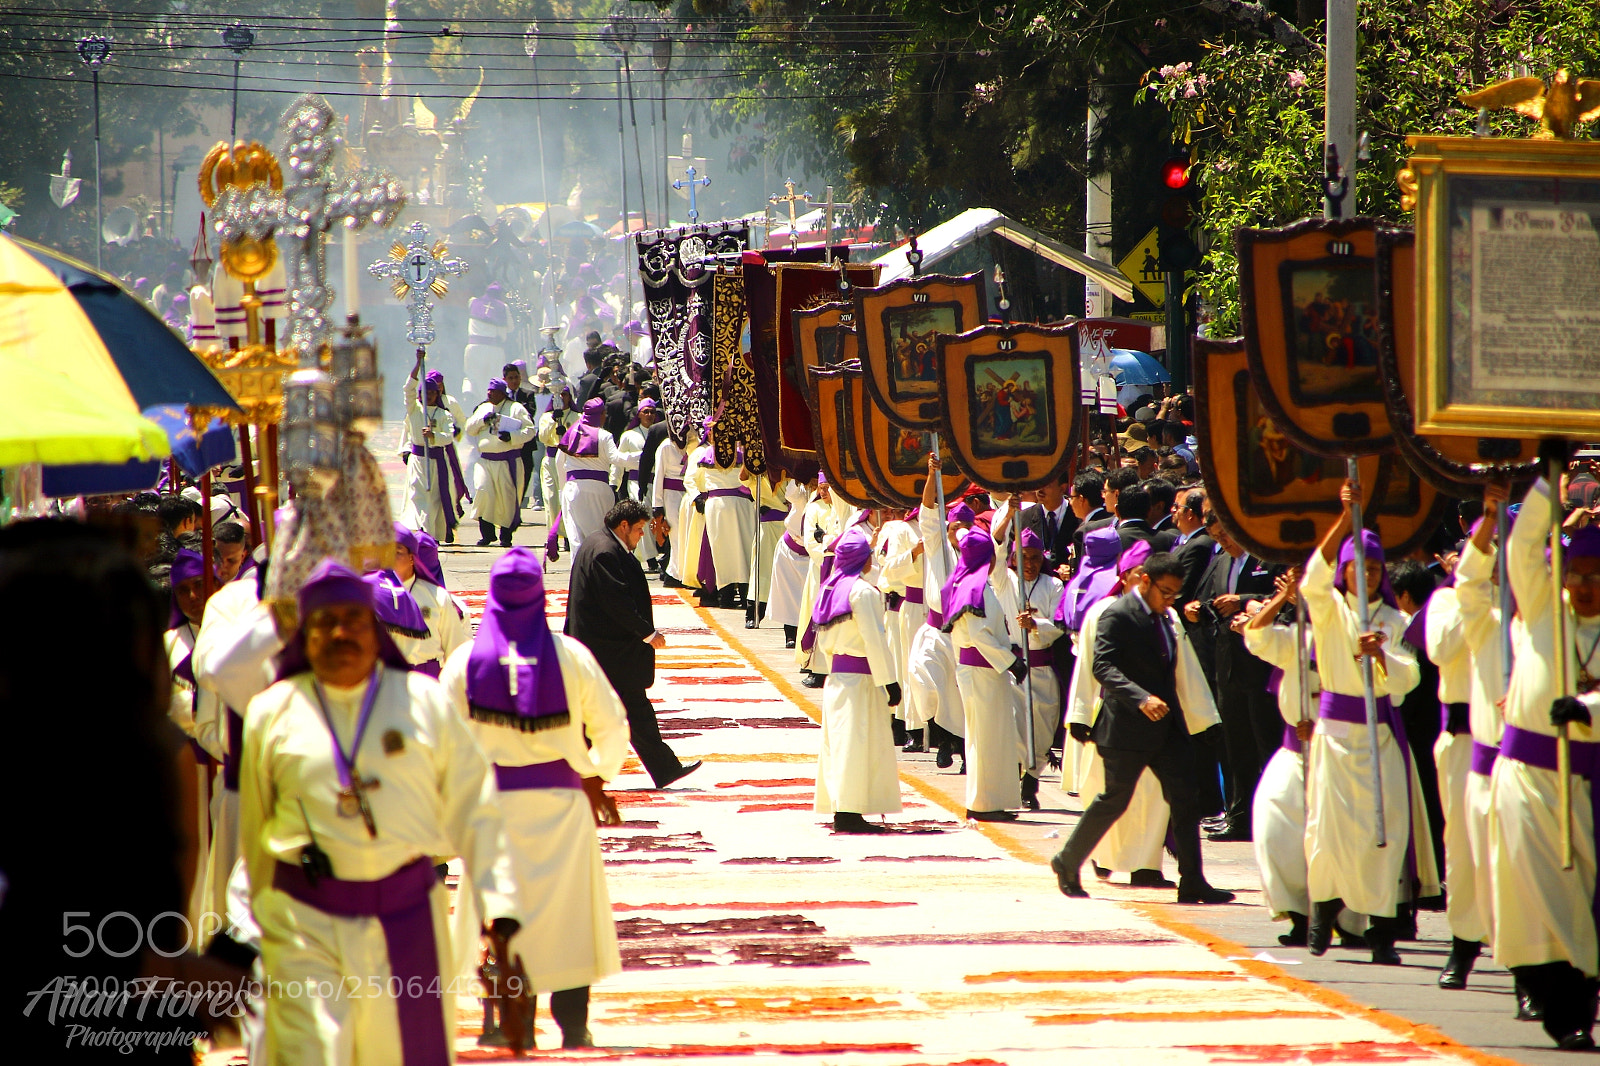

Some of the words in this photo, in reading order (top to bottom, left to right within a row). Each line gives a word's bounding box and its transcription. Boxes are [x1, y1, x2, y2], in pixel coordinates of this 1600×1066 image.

[1333, 242, 1349, 255] III
[913, 293, 927, 303] VII
[840, 313, 853, 321] XIV
[1000, 340, 1012, 350] VI
